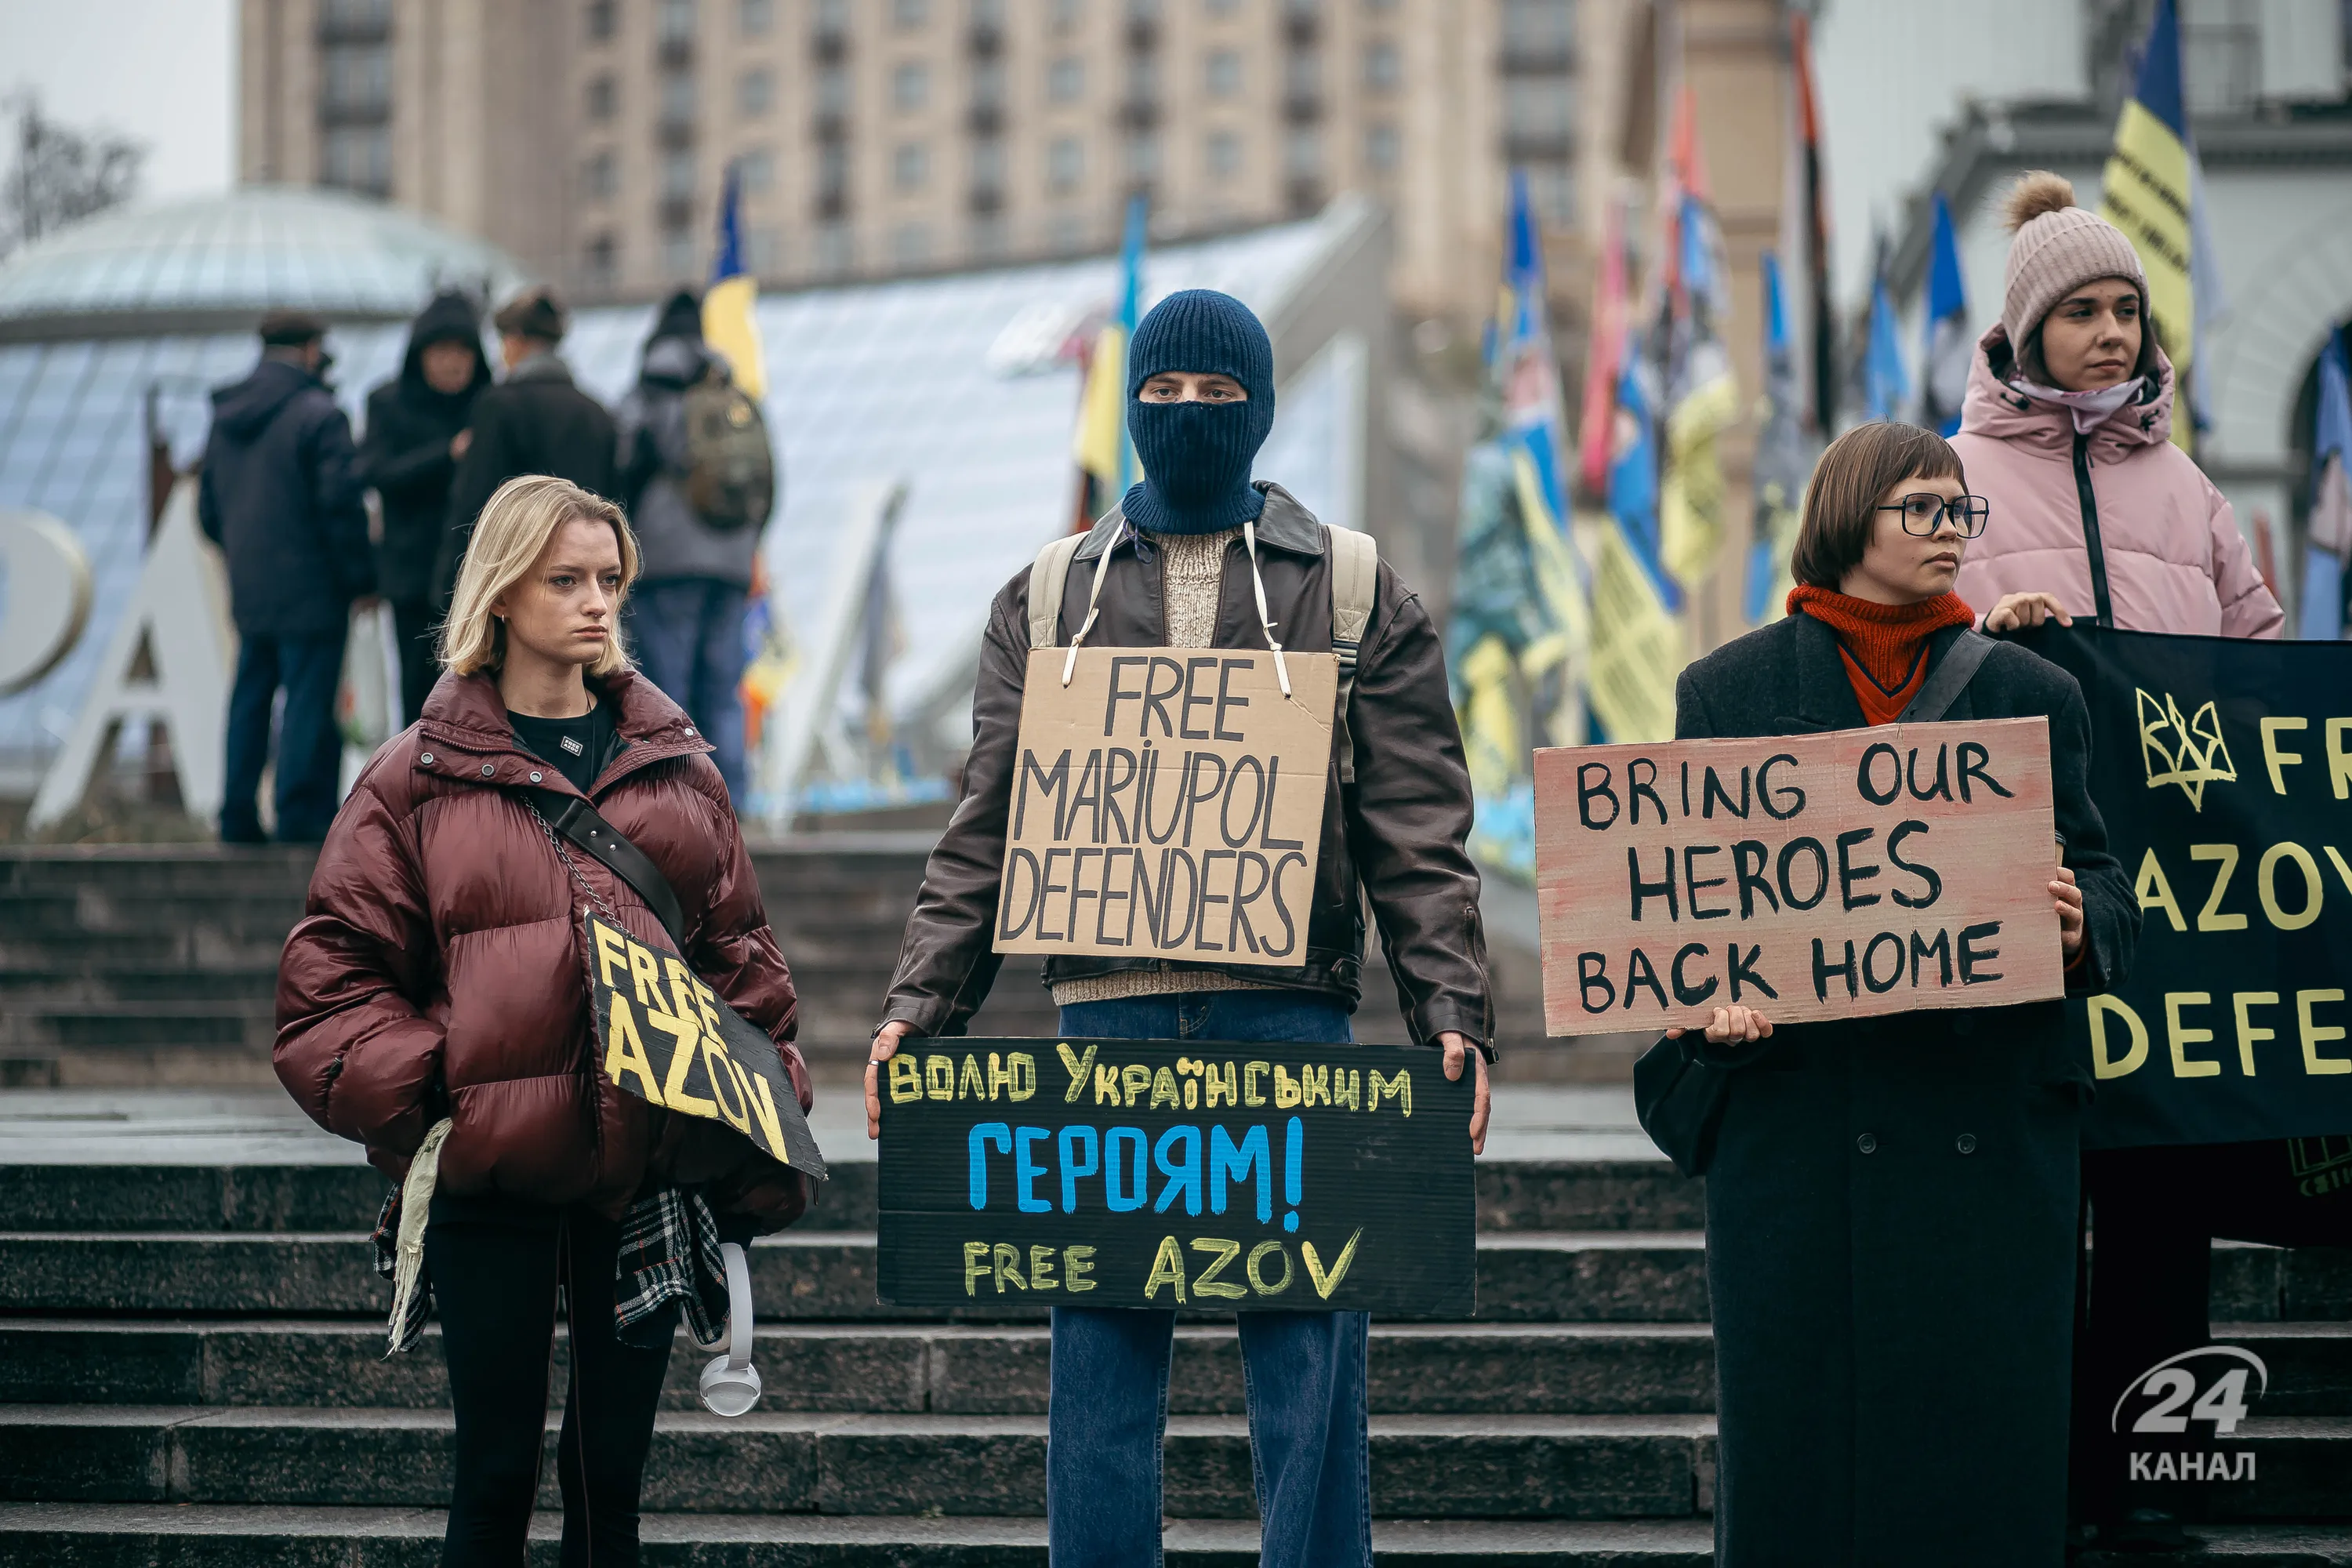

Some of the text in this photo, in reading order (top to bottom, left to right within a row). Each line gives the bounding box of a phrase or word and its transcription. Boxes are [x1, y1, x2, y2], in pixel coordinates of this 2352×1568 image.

[564, 739, 580, 750] FREE
[1104, 655, 1254, 742] FREE
[1577, 742, 2016, 831] BRING OUR
[999, 847, 1308, 958] DEFENDERS
[1628, 819, 1943, 922] HEROES
[592, 918, 729, 1054] FREE
[1577, 919, 2005, 1014] BACK HOME
[604, 989, 789, 1164] AZOV
[887, 1051, 1036, 1105] ВОЛЮ
[968, 1115, 1304, 1234] ГЕРОЯМ!
[964, 1225, 1364, 1306] FREE AZOV
